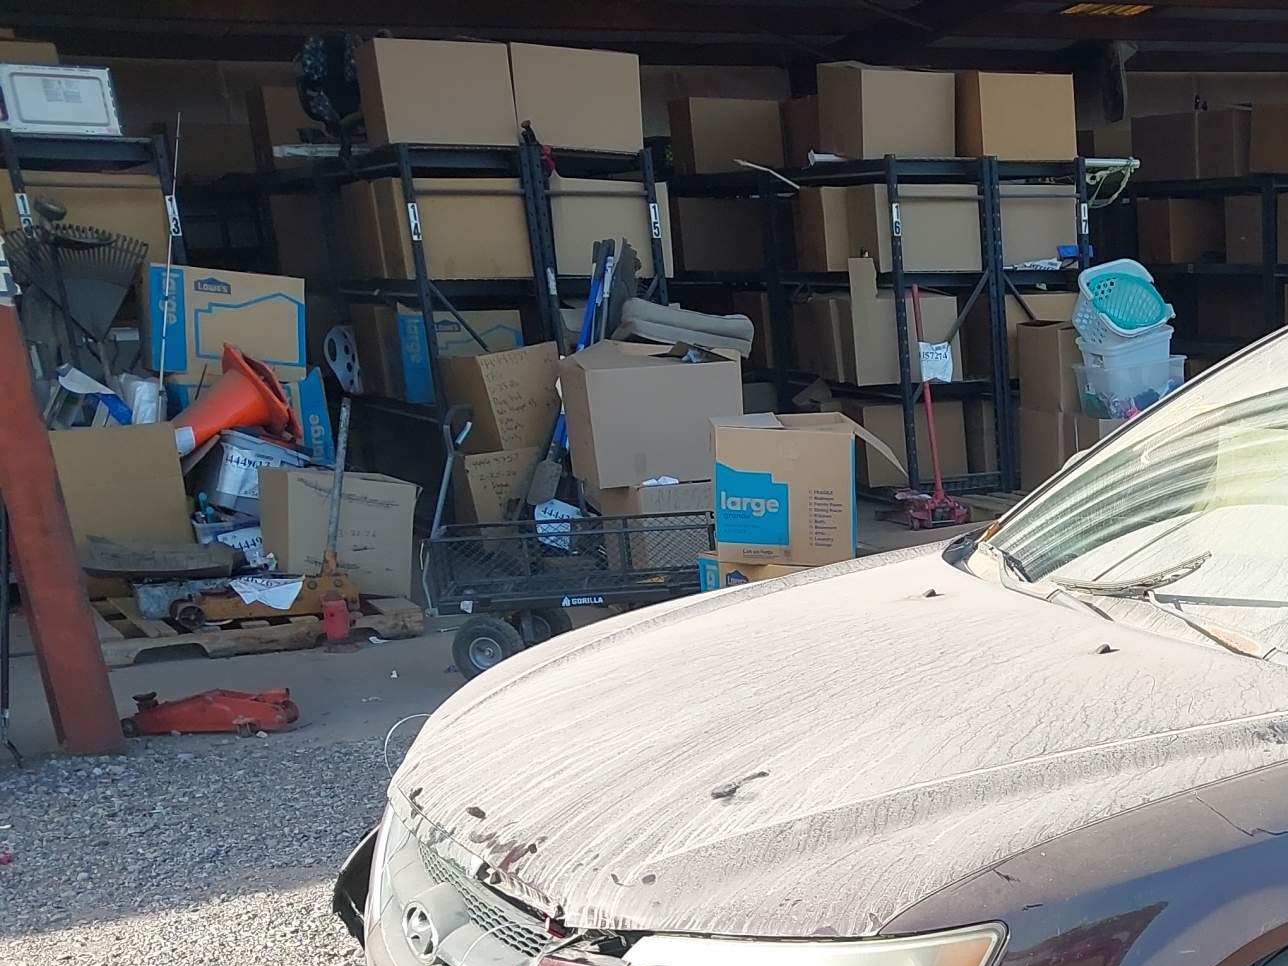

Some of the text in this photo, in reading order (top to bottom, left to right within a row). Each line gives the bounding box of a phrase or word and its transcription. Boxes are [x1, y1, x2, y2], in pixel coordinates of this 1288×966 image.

[409, 203, 422, 240] 14
[650, 204, 662, 238] 15
[893, 204, 901, 236] 16
[1081, 203, 1089, 233] 17
[720, 491, 780, 517] large
[571, 596, 604, 605] GORILLA
